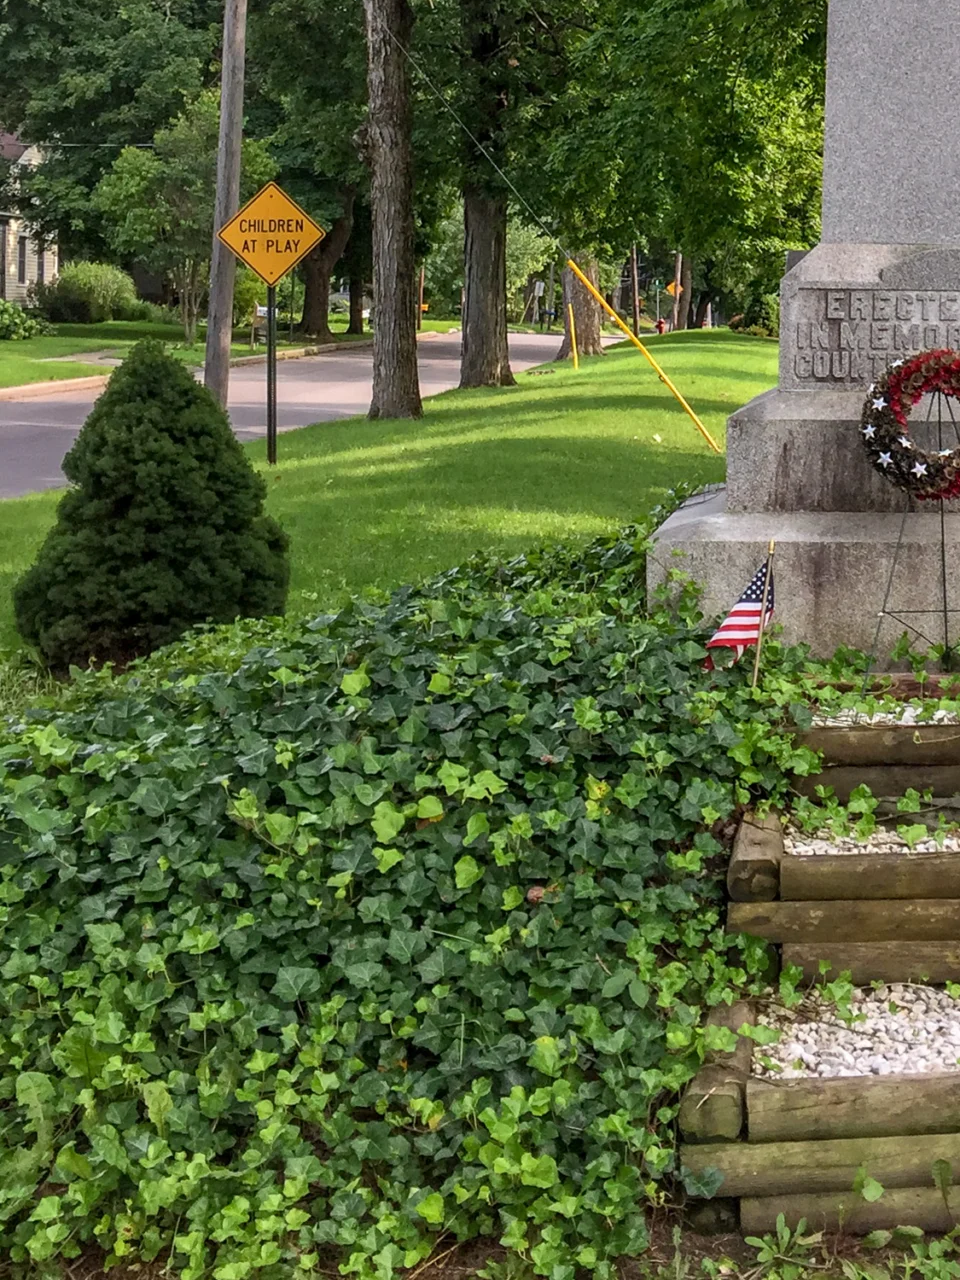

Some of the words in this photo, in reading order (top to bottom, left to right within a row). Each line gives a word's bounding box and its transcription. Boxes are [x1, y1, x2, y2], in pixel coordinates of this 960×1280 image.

[239, 219, 304, 233] CHILDREN
[241, 239, 257, 253] AT
[266, 239, 301, 253] PLAY
[797, 322, 830, 350] IN
